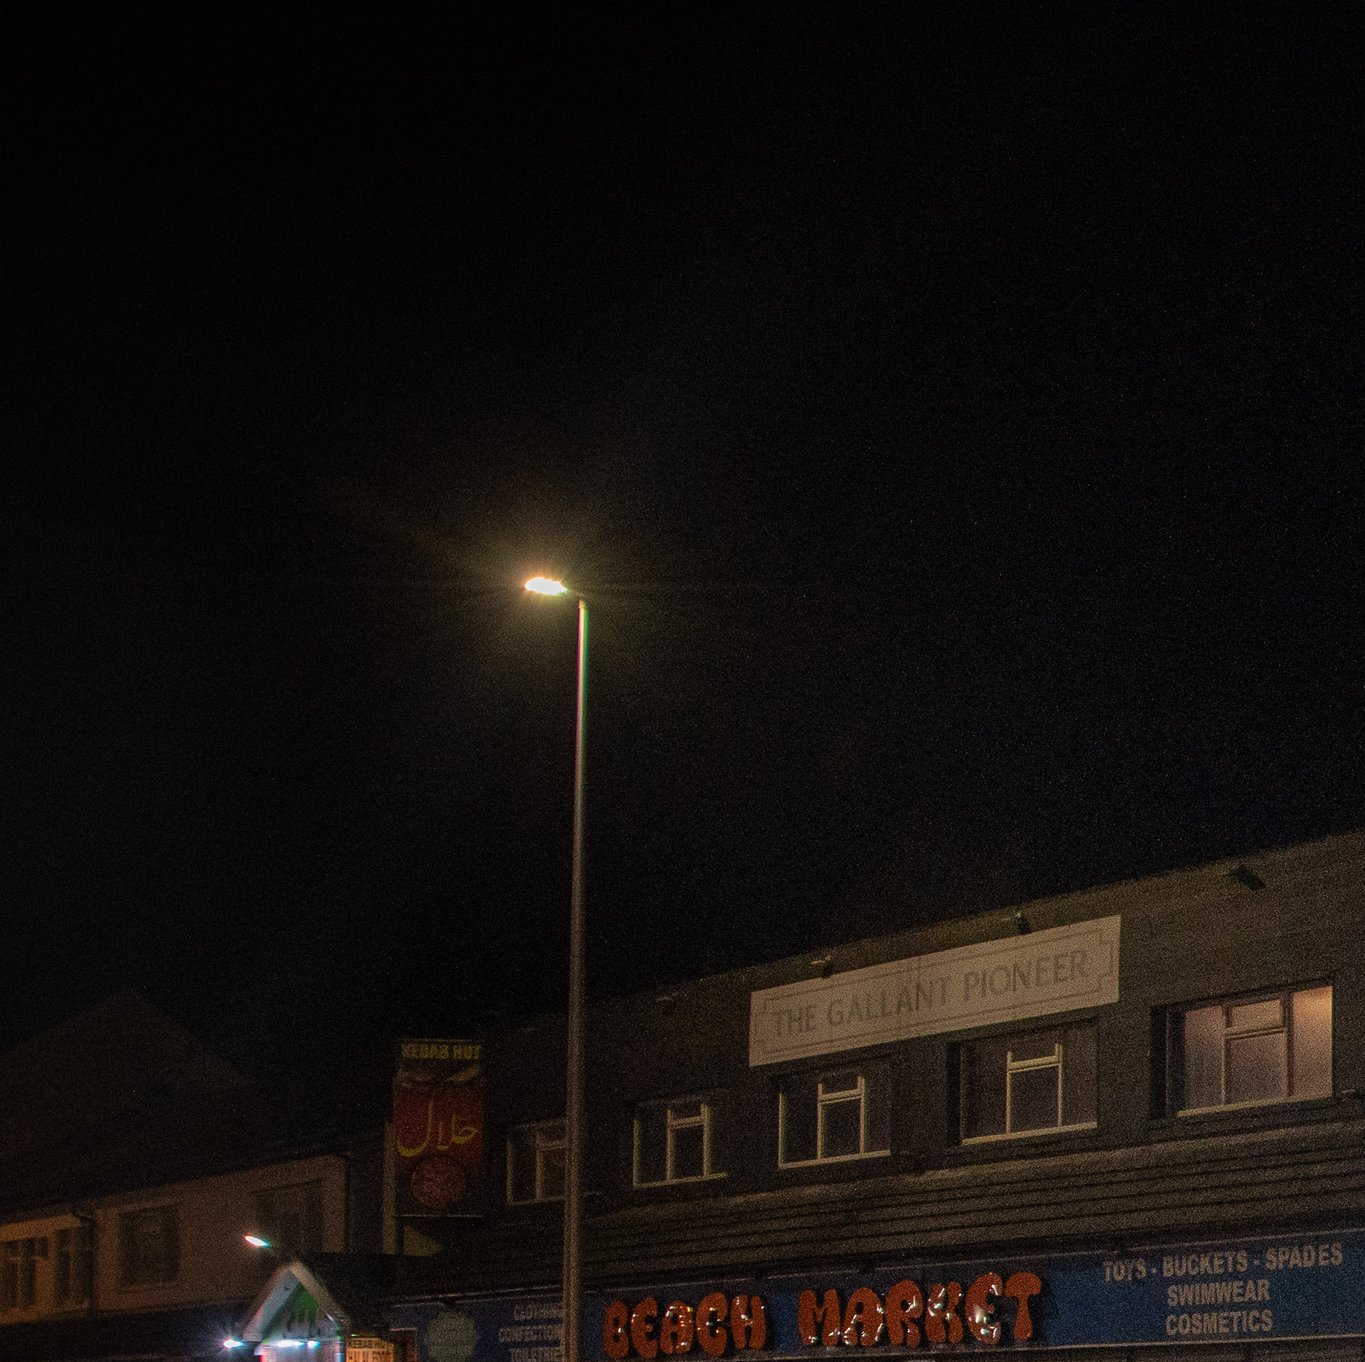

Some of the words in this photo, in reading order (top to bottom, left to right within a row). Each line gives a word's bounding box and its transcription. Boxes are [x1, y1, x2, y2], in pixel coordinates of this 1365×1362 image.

[773, 1007, 817, 1038] THE
[826, 976, 952, 1029] GALLANT
[963, 948, 1088, 1000] PIONEER
[1103, 1258, 1147, 1283] TOYS
[1161, 1252, 1249, 1279] BUCKETS
[1264, 1242, 1343, 1270] SPADES
[1166, 1279, 1271, 1308] SWIMWEAR
[602, 1288, 768, 1360] BEACH
[798, 1271, 1043, 1350] MARKET
[1164, 1310, 1274, 1337] COSMETICS
